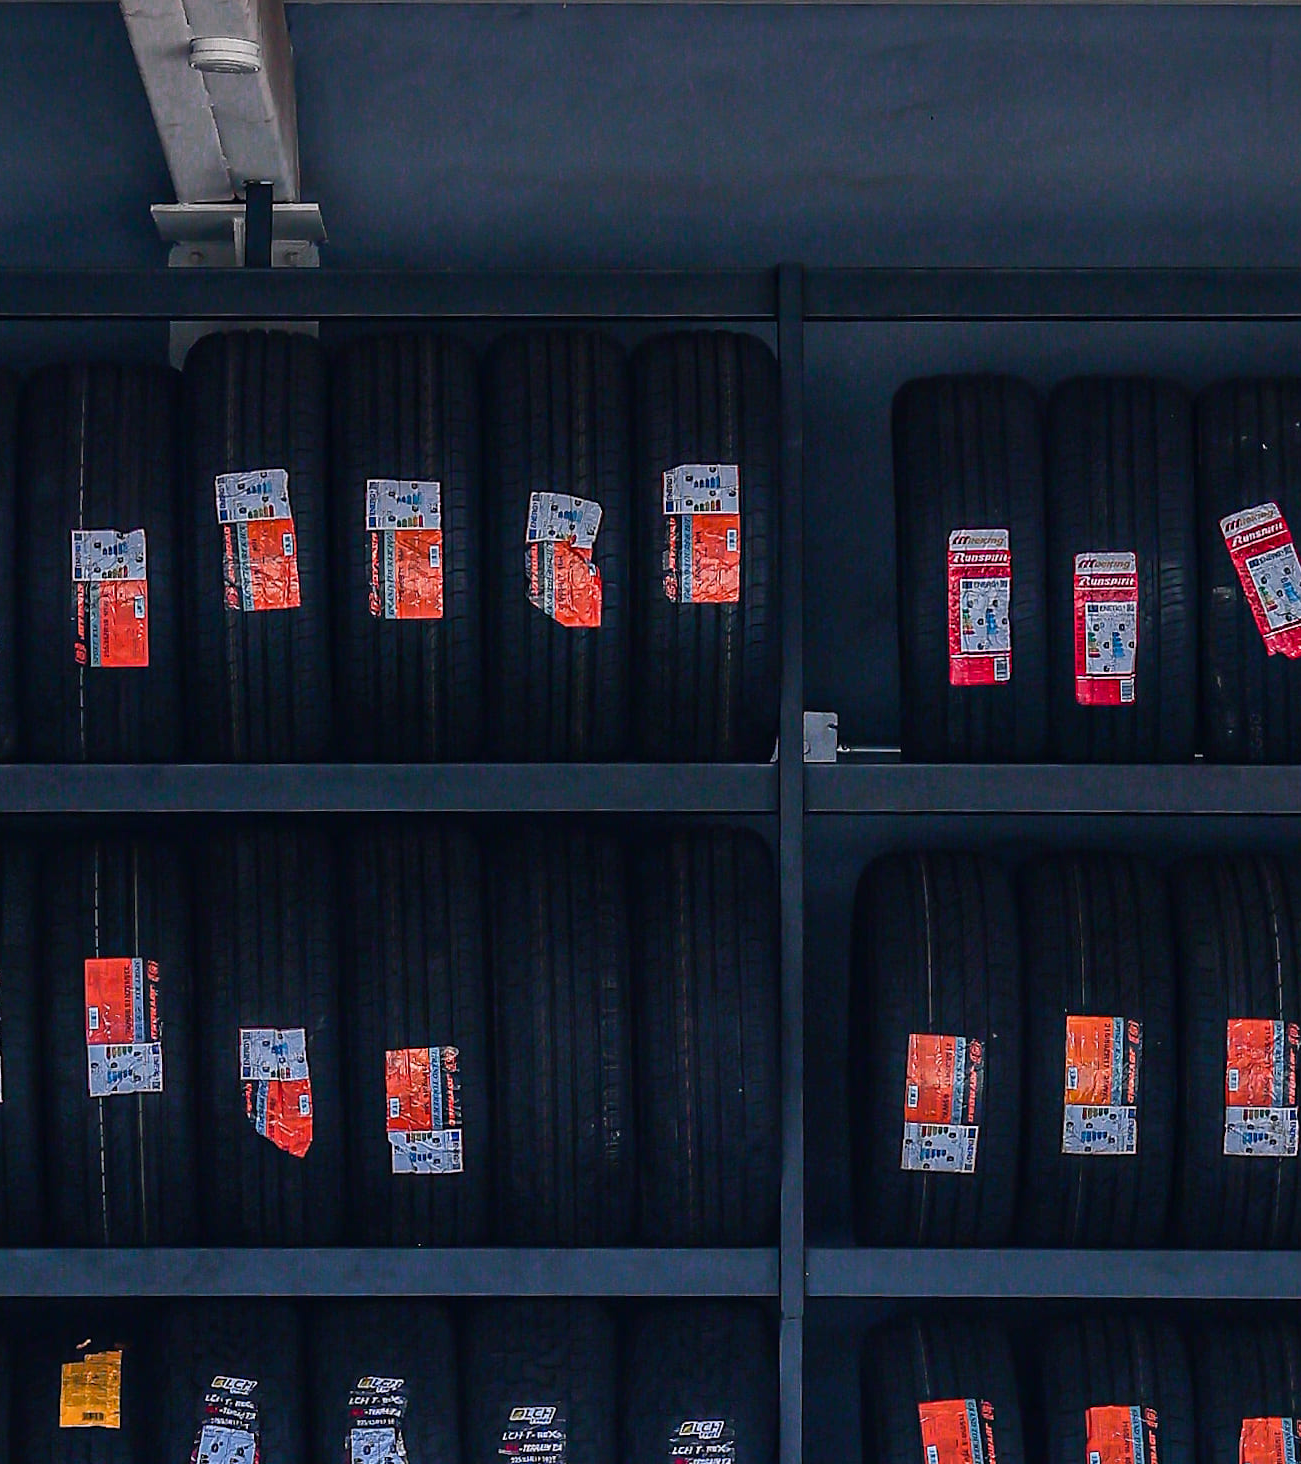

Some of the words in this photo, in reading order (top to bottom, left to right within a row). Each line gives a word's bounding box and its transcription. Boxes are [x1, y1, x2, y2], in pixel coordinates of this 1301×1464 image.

[1231, 521, 1285, 548] Runspirit
[952, 551, 1008, 564] Runspirit
[1079, 575, 1135, 588] Runspirit
